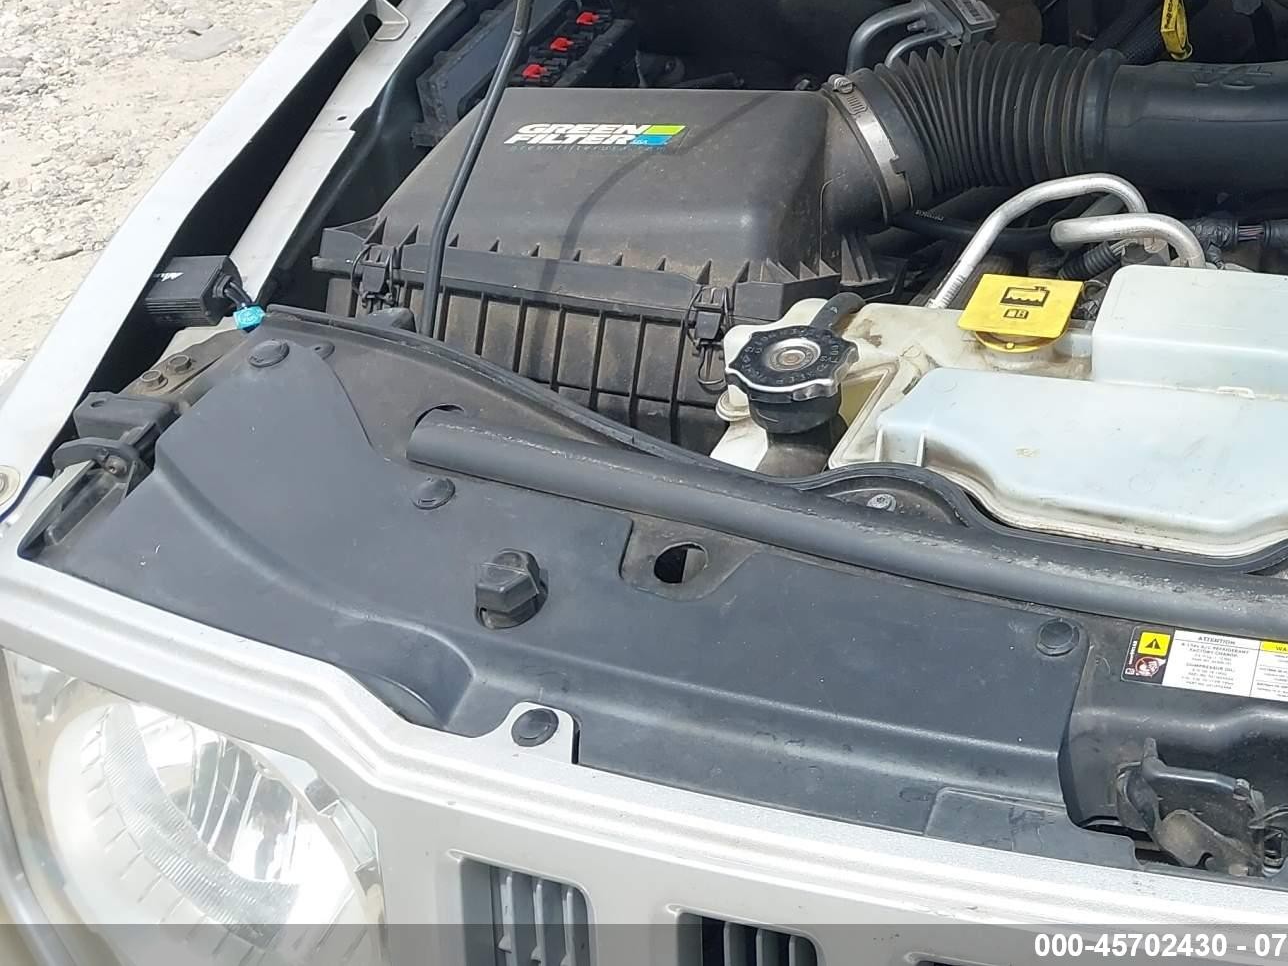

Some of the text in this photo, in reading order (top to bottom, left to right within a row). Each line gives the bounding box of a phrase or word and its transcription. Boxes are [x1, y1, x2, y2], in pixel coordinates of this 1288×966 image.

[517, 123, 651, 135] GREEN
[504, 134, 639, 145] FILTER
[1198, 636, 1236, 645] ATTENTION
